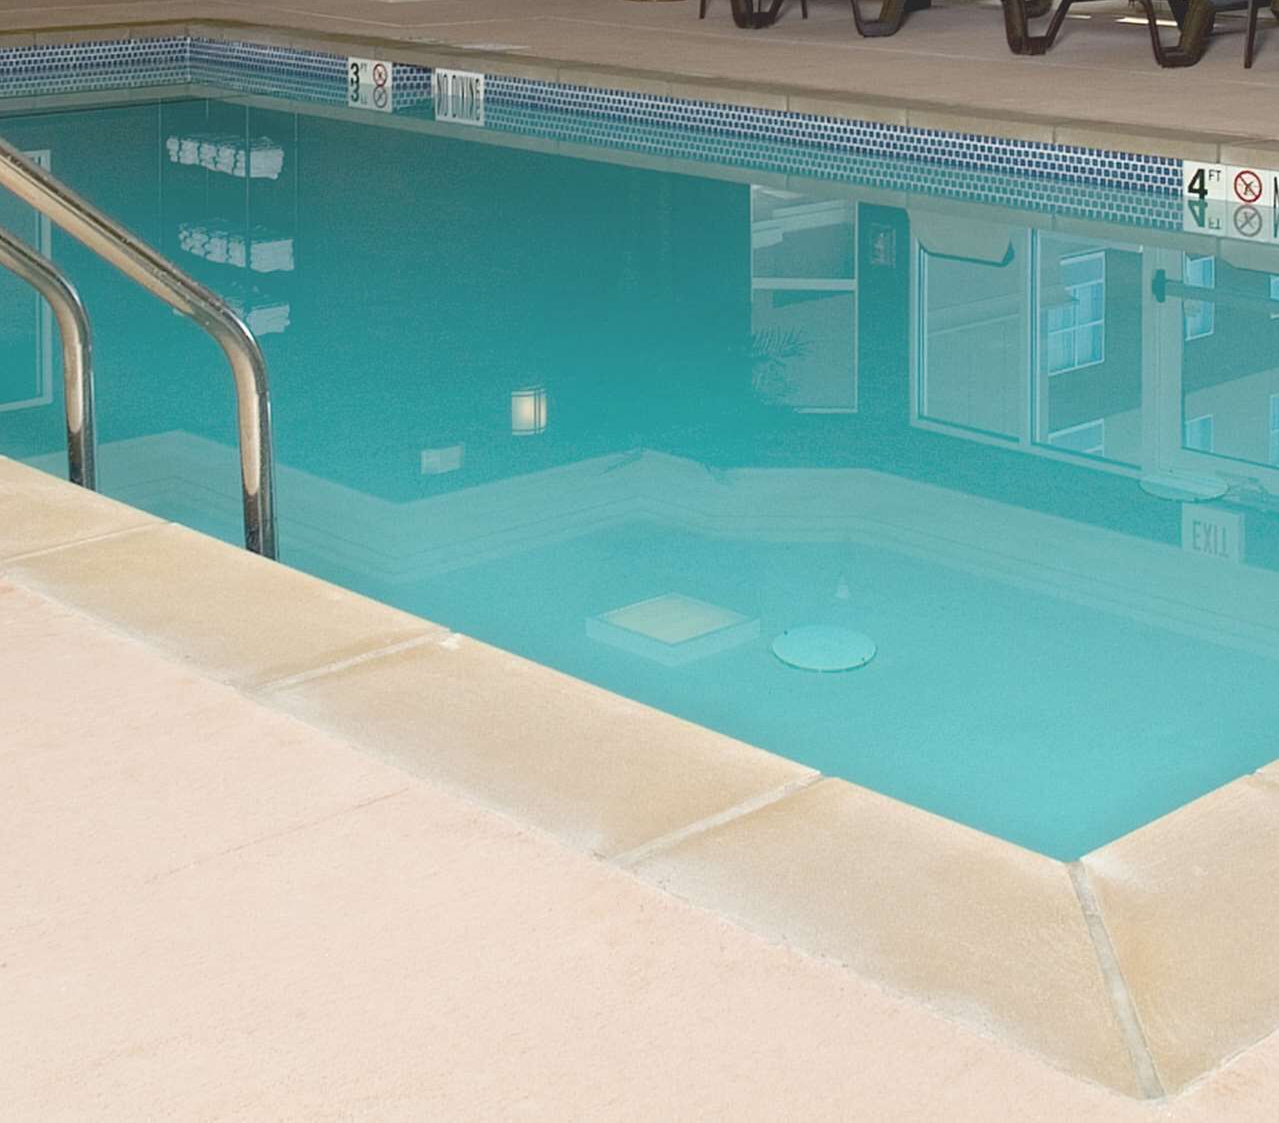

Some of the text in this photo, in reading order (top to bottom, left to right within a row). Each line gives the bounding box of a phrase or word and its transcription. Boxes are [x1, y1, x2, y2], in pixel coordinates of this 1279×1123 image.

[350, 62, 360, 85] 3
[1187, 168, 1208, 200] 4
[1208, 169, 1222, 182] FT
